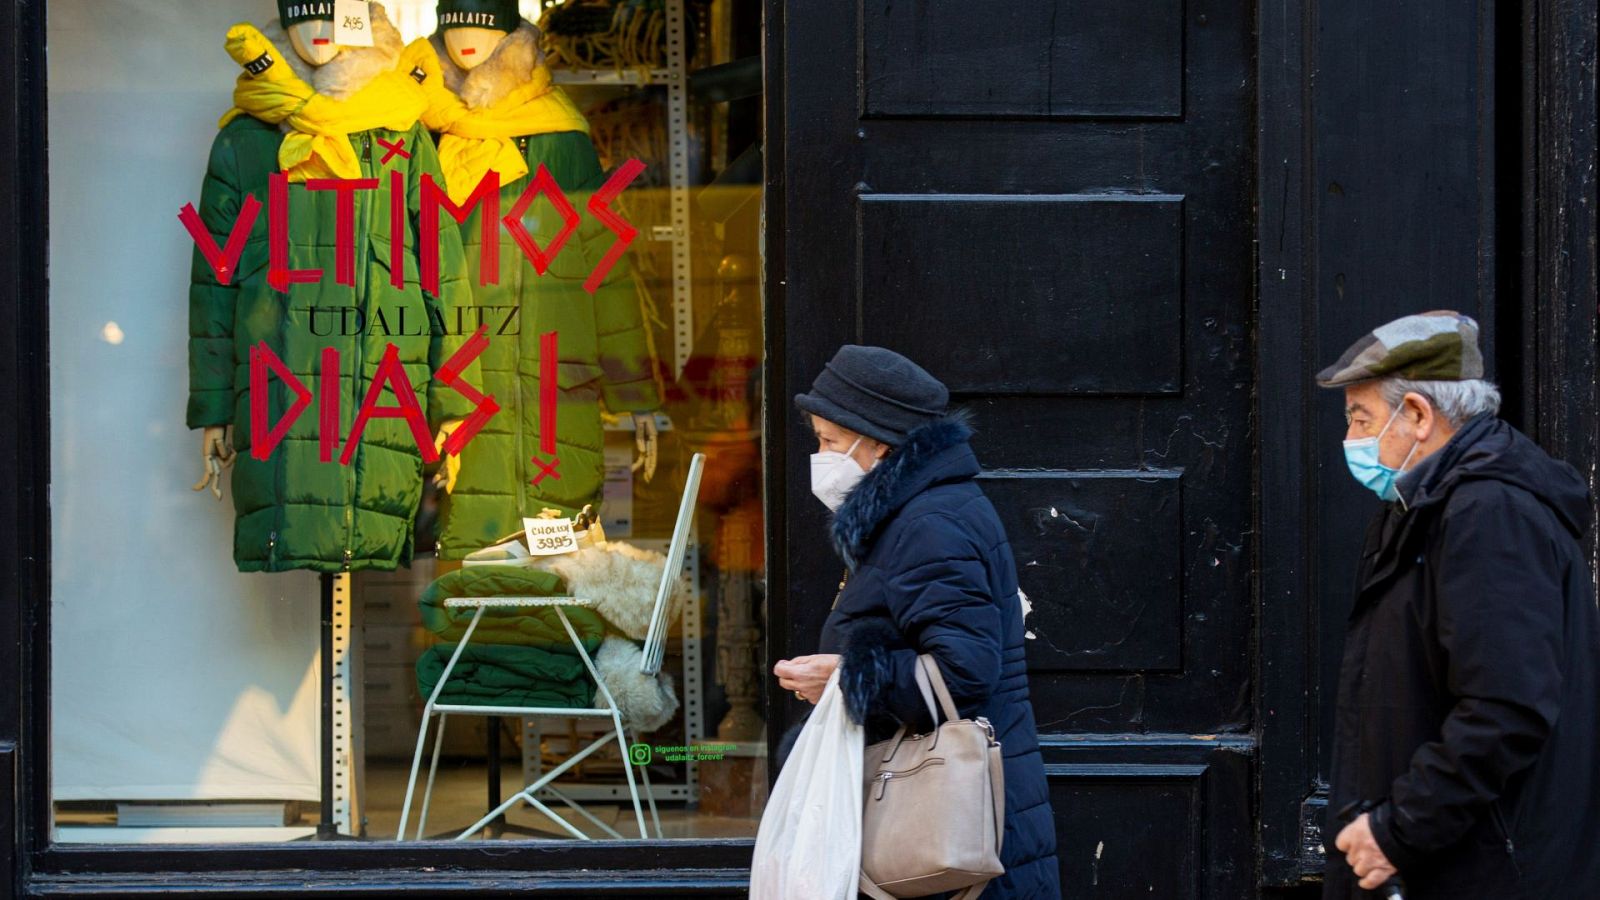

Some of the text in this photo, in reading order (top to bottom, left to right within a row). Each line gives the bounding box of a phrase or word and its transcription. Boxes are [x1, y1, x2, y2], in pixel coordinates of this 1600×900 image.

[287, 2, 335, 18] UDALAI
[440, 12, 495, 26] UDALAITZ
[308, 305, 521, 336] UDALAITZ
[537, 536, 573, 550] 39,95
